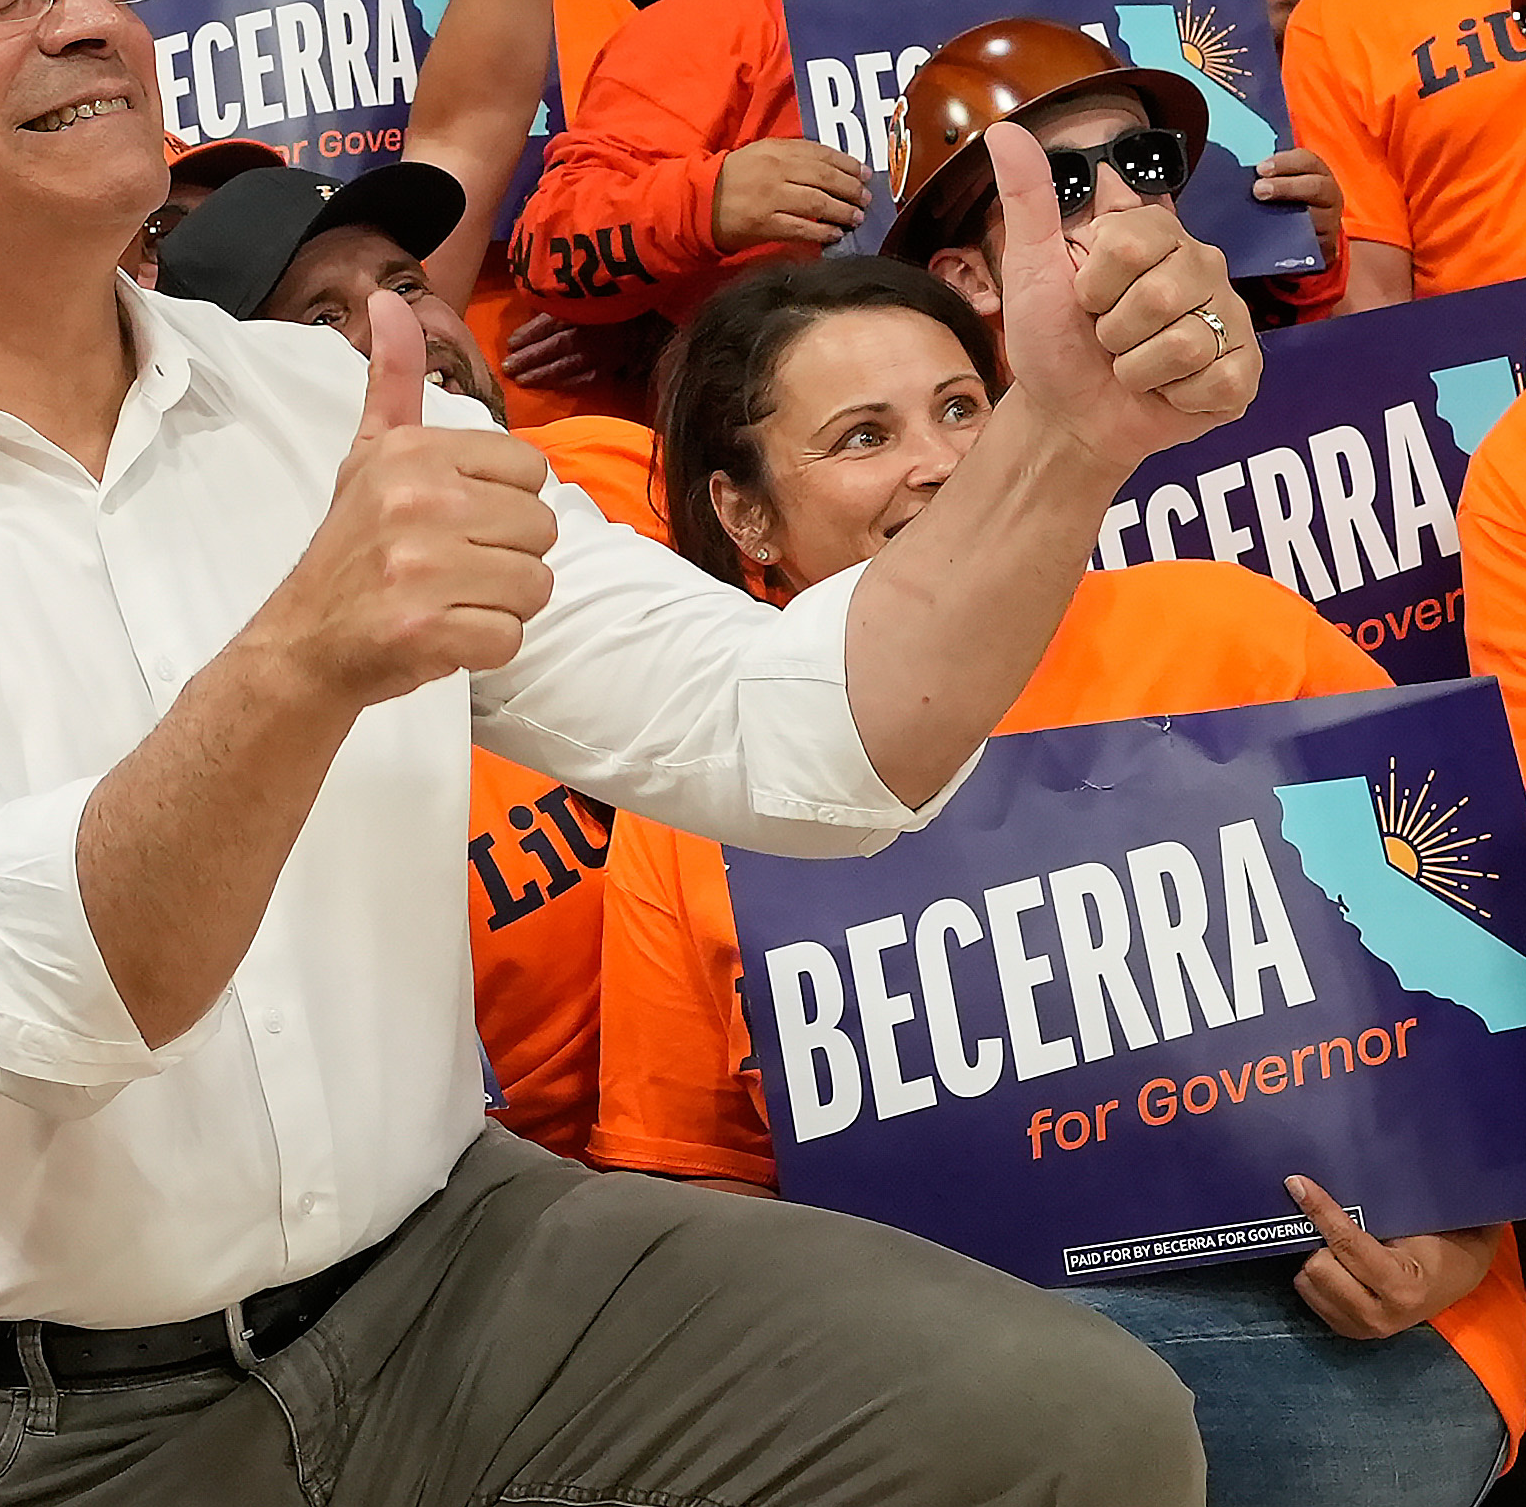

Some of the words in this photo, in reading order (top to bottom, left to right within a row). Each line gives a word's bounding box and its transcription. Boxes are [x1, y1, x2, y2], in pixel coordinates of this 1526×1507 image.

[319, 126, 407, 159] Gove
[550, 223, 659, 299] 324
[1334, 588, 1464, 652] over
[765, 819, 1316, 1142] BECERRA
[1028, 1100, 1118, 1159] for
[1138, 1018, 1416, 1125] Governor
[1070, 1252, 1101, 1268] PAID
[1103, 1248, 1132, 1263] FOR
[1134, 1245, 1151, 1260] BY
[1154, 1236, 1216, 1256] BECERRA
[1218, 1231, 1245, 1247] FOR
[1248, 1221, 1315, 1243] GOVERNO
